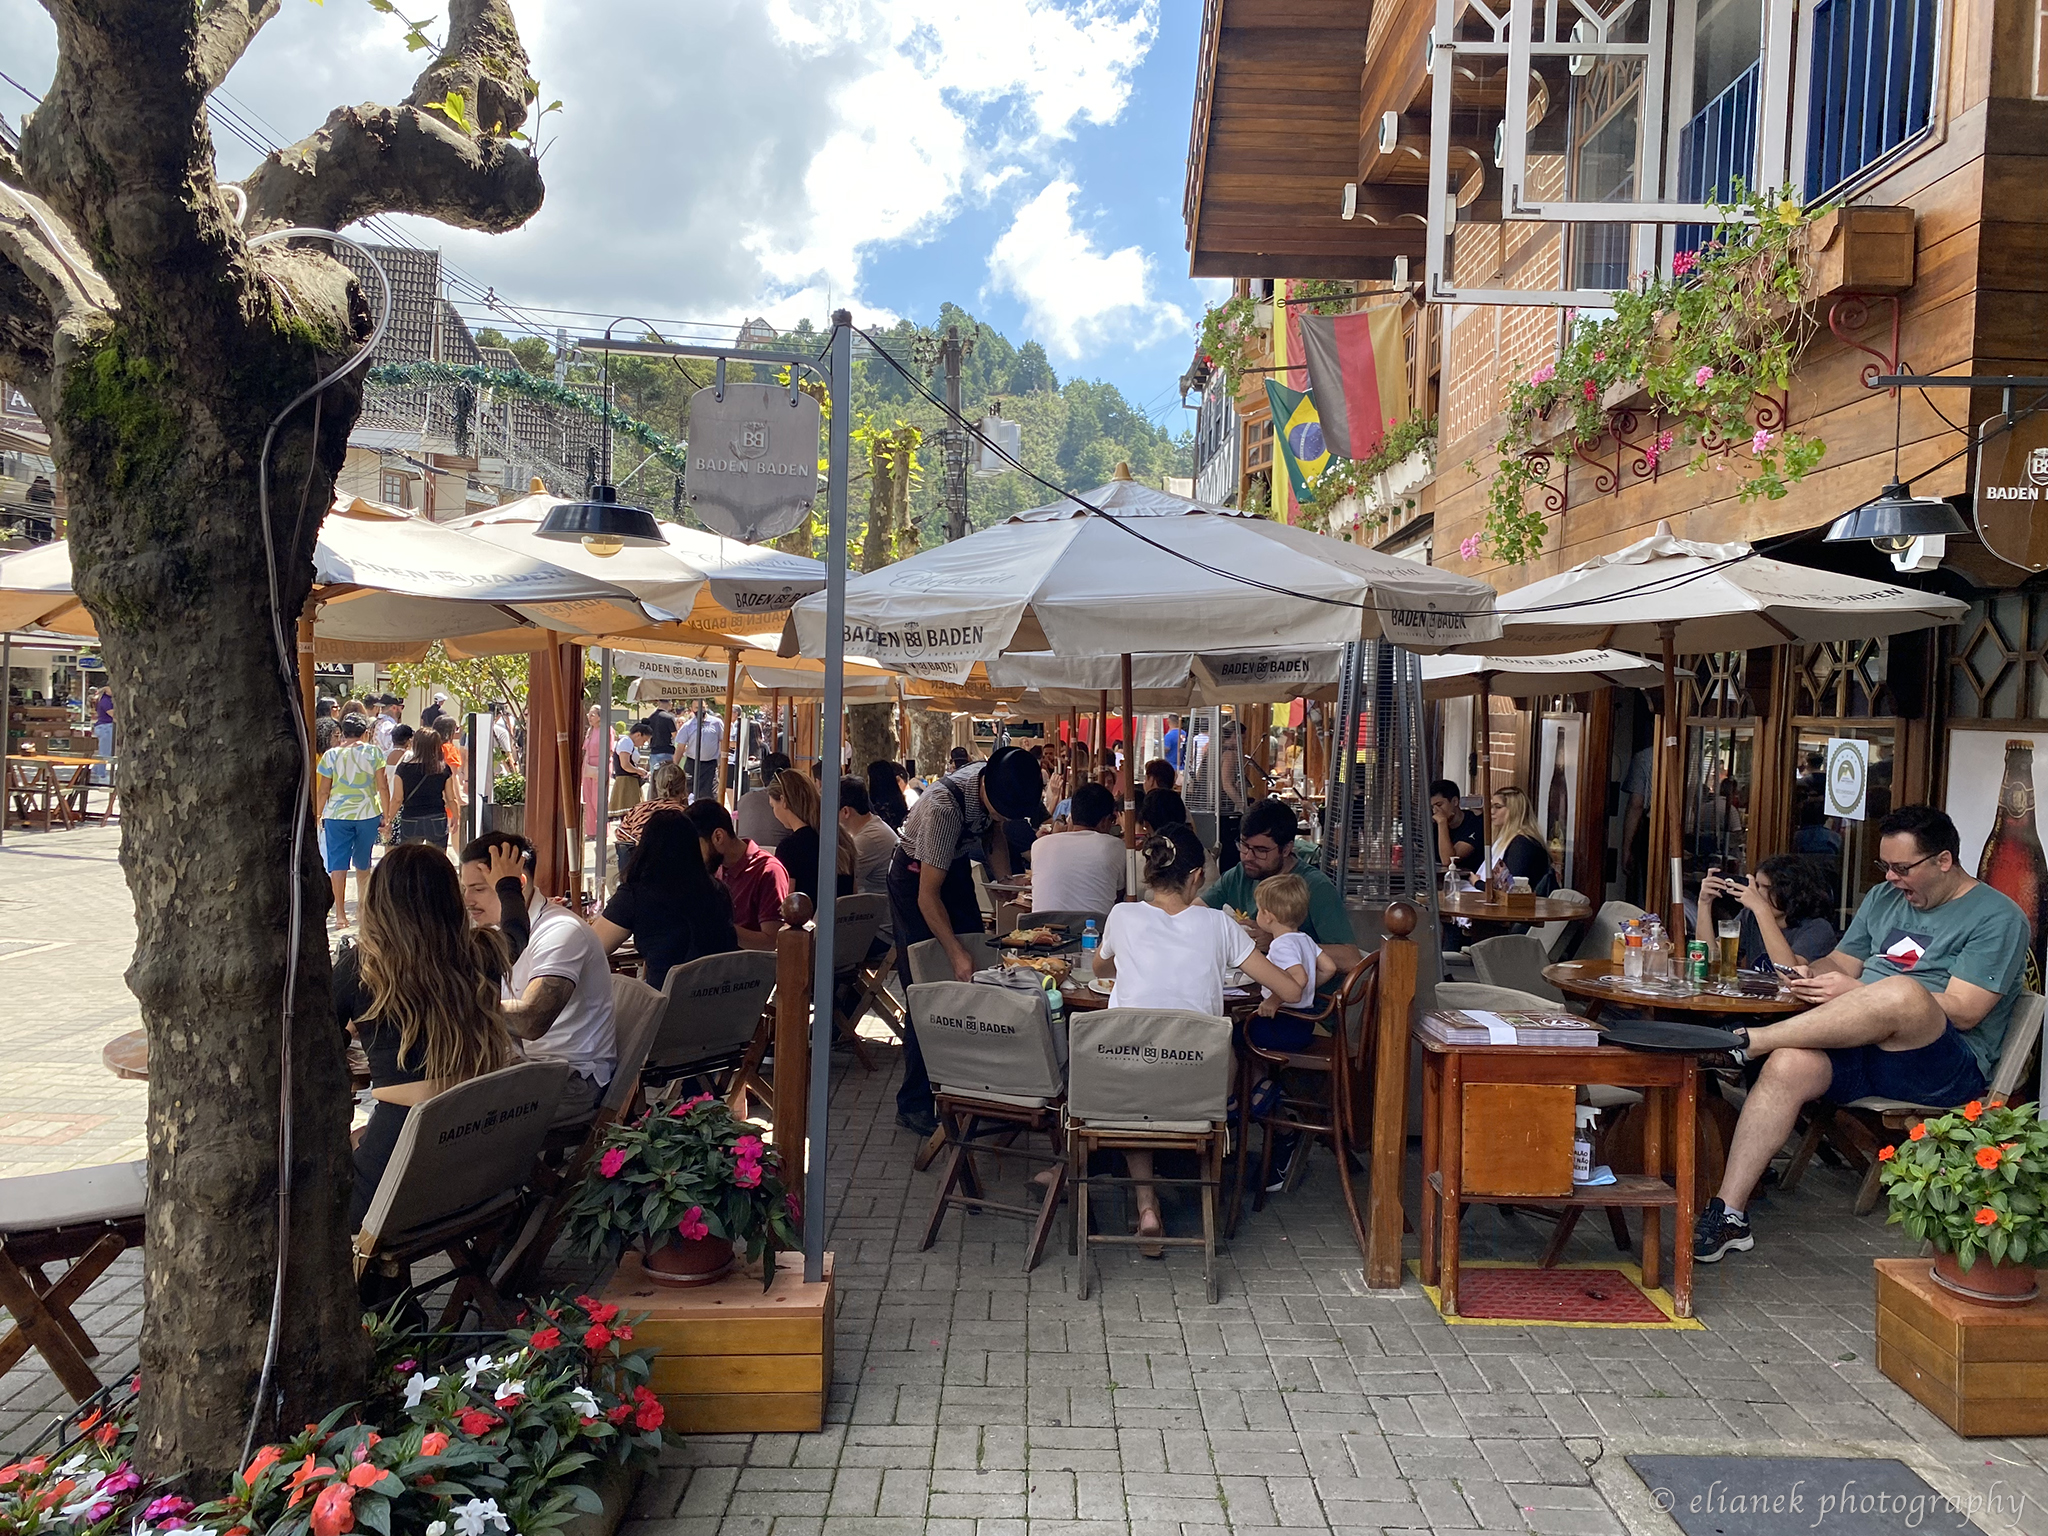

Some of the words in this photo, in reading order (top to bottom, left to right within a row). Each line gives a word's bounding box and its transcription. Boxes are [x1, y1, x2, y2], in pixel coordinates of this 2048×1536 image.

[696, 458, 748, 473] BADEN
[757, 462, 809, 477] BADEN
[1986, 486, 2039, 500] BADEN
[470, 569, 566, 583] BADEN
[735, 593, 776, 608] BADEN
[1840, 587, 1904, 601] BADEN
[1392, 609, 1426, 627] BADEN
[843, 625, 900, 647] BADEN
[927, 626, 983, 647] BADEN
[1558, 653, 1609, 665] BADEN
[639, 661, 670, 674] BADEN
[685, 667, 718, 679] BADEN
[929, 661, 959, 674] BADEN
[1221, 661, 1254, 675] BADEN
[1270, 660, 1310, 673] BADEN
[661, 686, 688, 695] BADEN
[700, 685, 726, 693] BADEN
[733, 980, 761, 992] BADEN
[930, 1014, 963, 1028] BADEN
[979, 1021, 1015, 1034] BADEN
[1098, 1044, 1140, 1055] BADEN
[1161, 1048, 1204, 1060] BADEN
[438, 1120, 481, 1144] BADEN
[499, 1101, 539, 1123] BADEN
